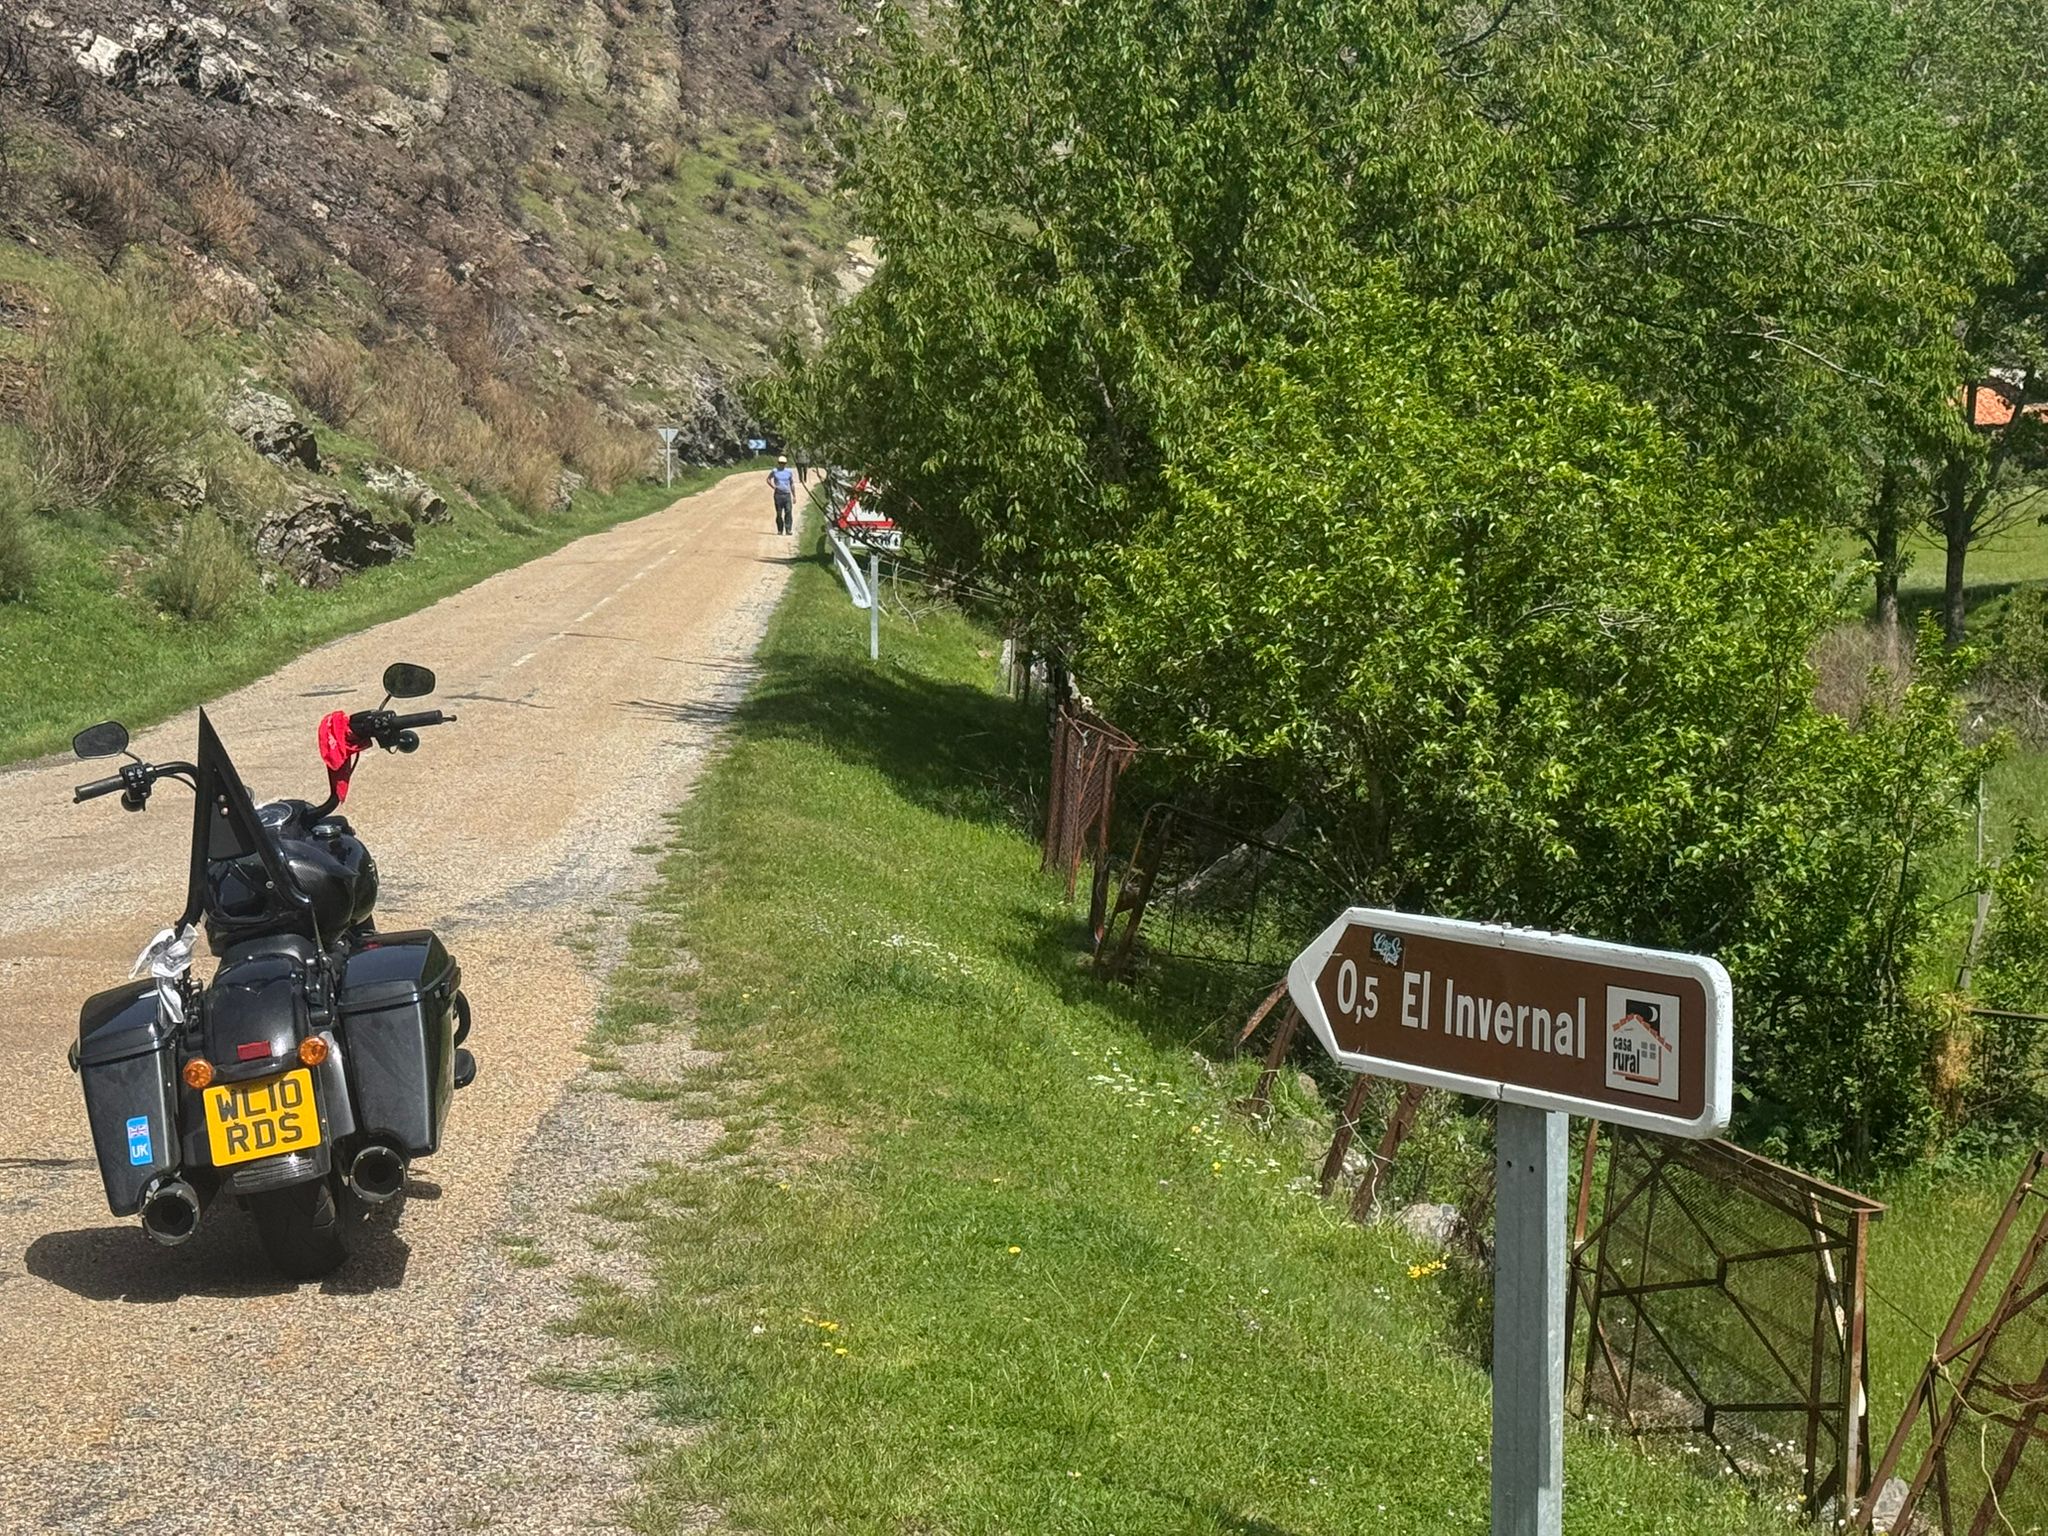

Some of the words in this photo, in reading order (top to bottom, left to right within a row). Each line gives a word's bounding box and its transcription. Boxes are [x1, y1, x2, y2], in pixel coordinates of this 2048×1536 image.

[1337, 959, 1378, 1023] 0,5
[1401, 971, 1431, 1030] El
[1445, 978, 1586, 1059] Invernal
[1613, 1036, 1632, 1052] casa
[1613, 1049, 1639, 1074] rural
[215, 1078, 303, 1122] WL10
[132, 1143, 149, 1158] UK
[226, 1112, 303, 1155] RDS
